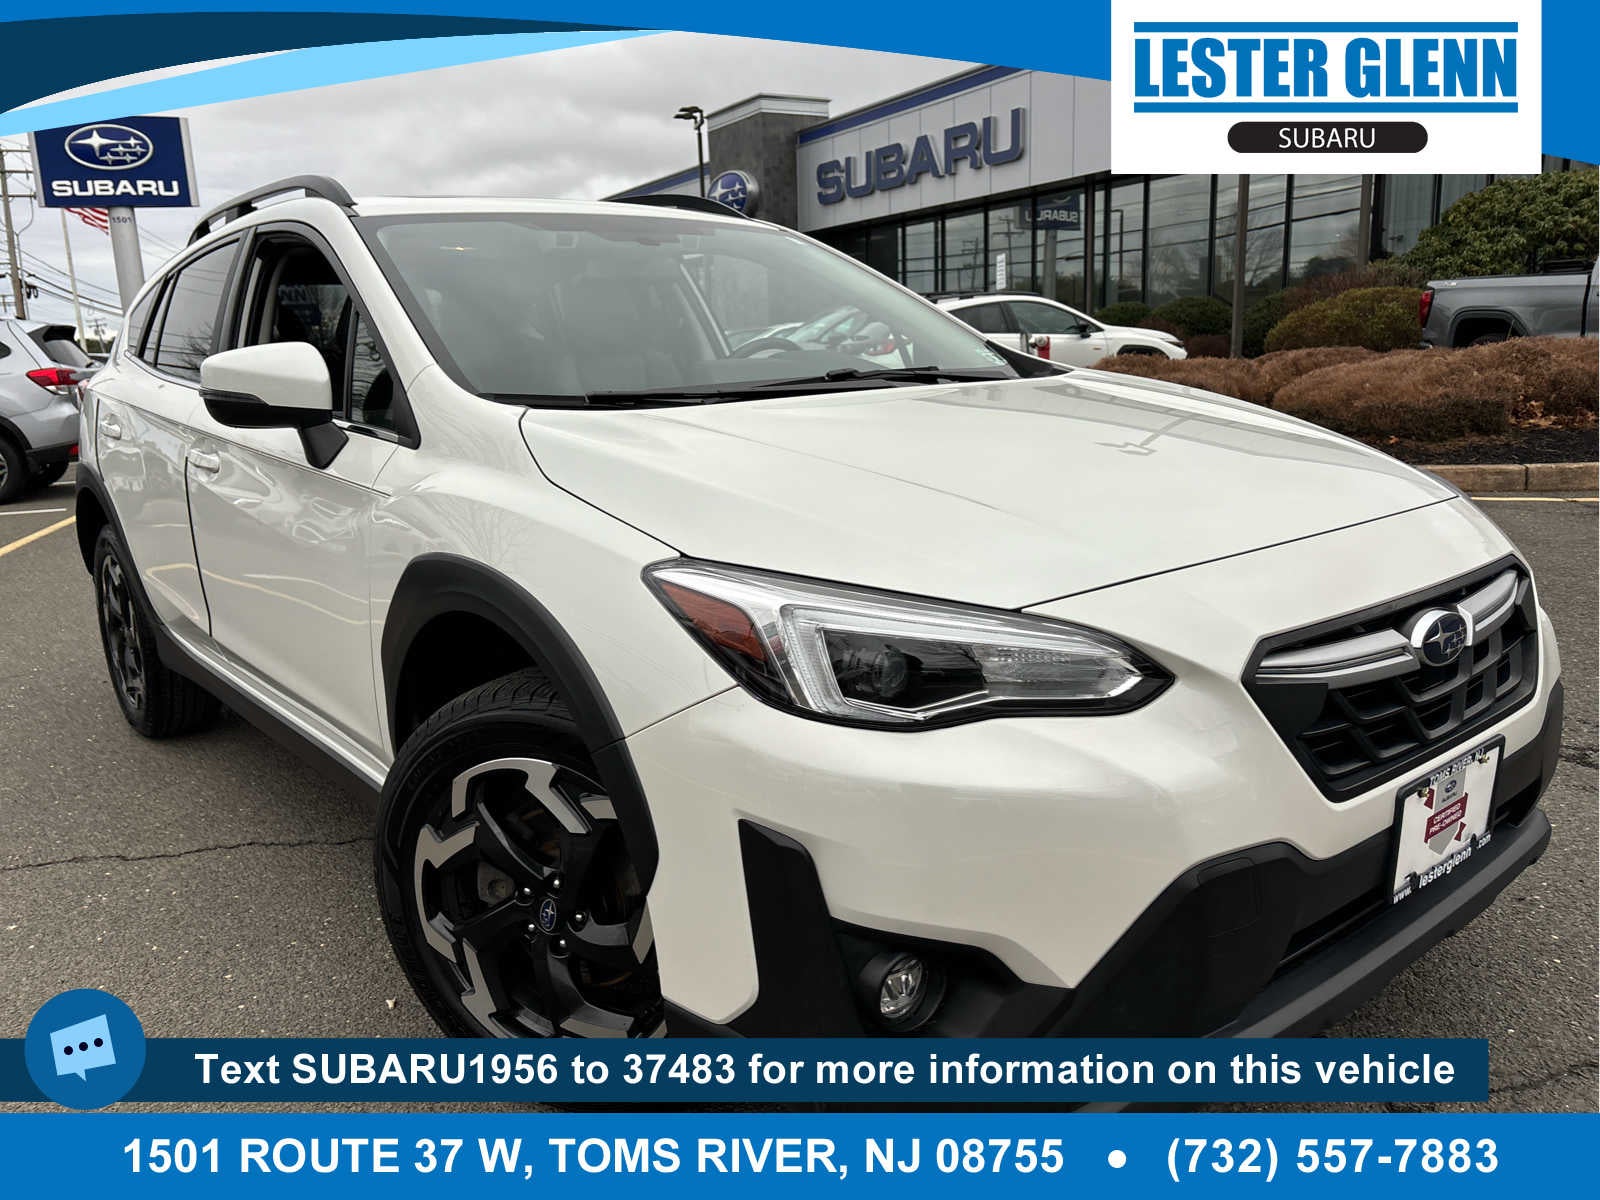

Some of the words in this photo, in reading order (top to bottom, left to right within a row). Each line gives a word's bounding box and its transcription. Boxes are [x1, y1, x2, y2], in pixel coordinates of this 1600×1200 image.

[815, 107, 1027, 206] SUBARU
[51, 179, 180, 197] SUBARU
[112, 215, 133, 224] 1501
[1430, 767, 1451, 786] TOMS
[1418, 846, 1472, 888] lesterglenn
